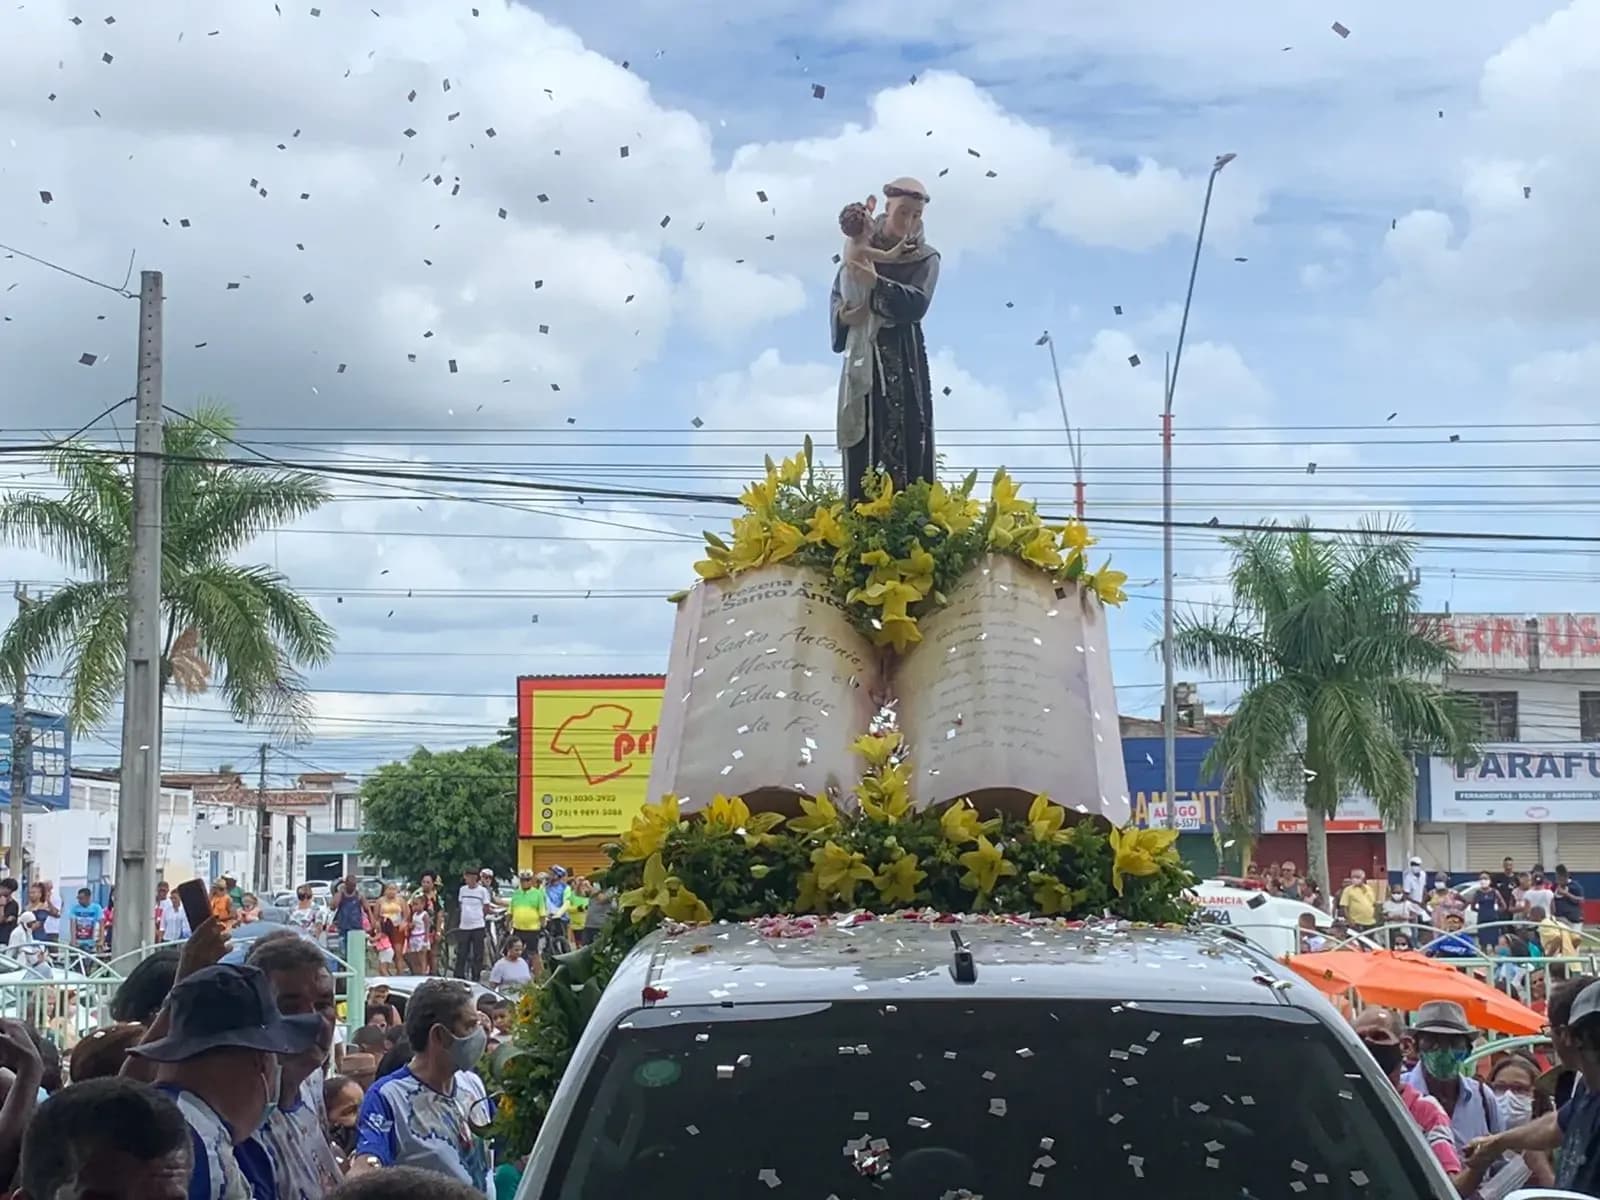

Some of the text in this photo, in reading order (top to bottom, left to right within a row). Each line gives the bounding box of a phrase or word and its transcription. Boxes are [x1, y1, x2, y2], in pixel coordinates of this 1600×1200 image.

[722, 588, 787, 612] Santo
[706, 632, 768, 660] Santo
[1154, 805, 1197, 818] ALGO
